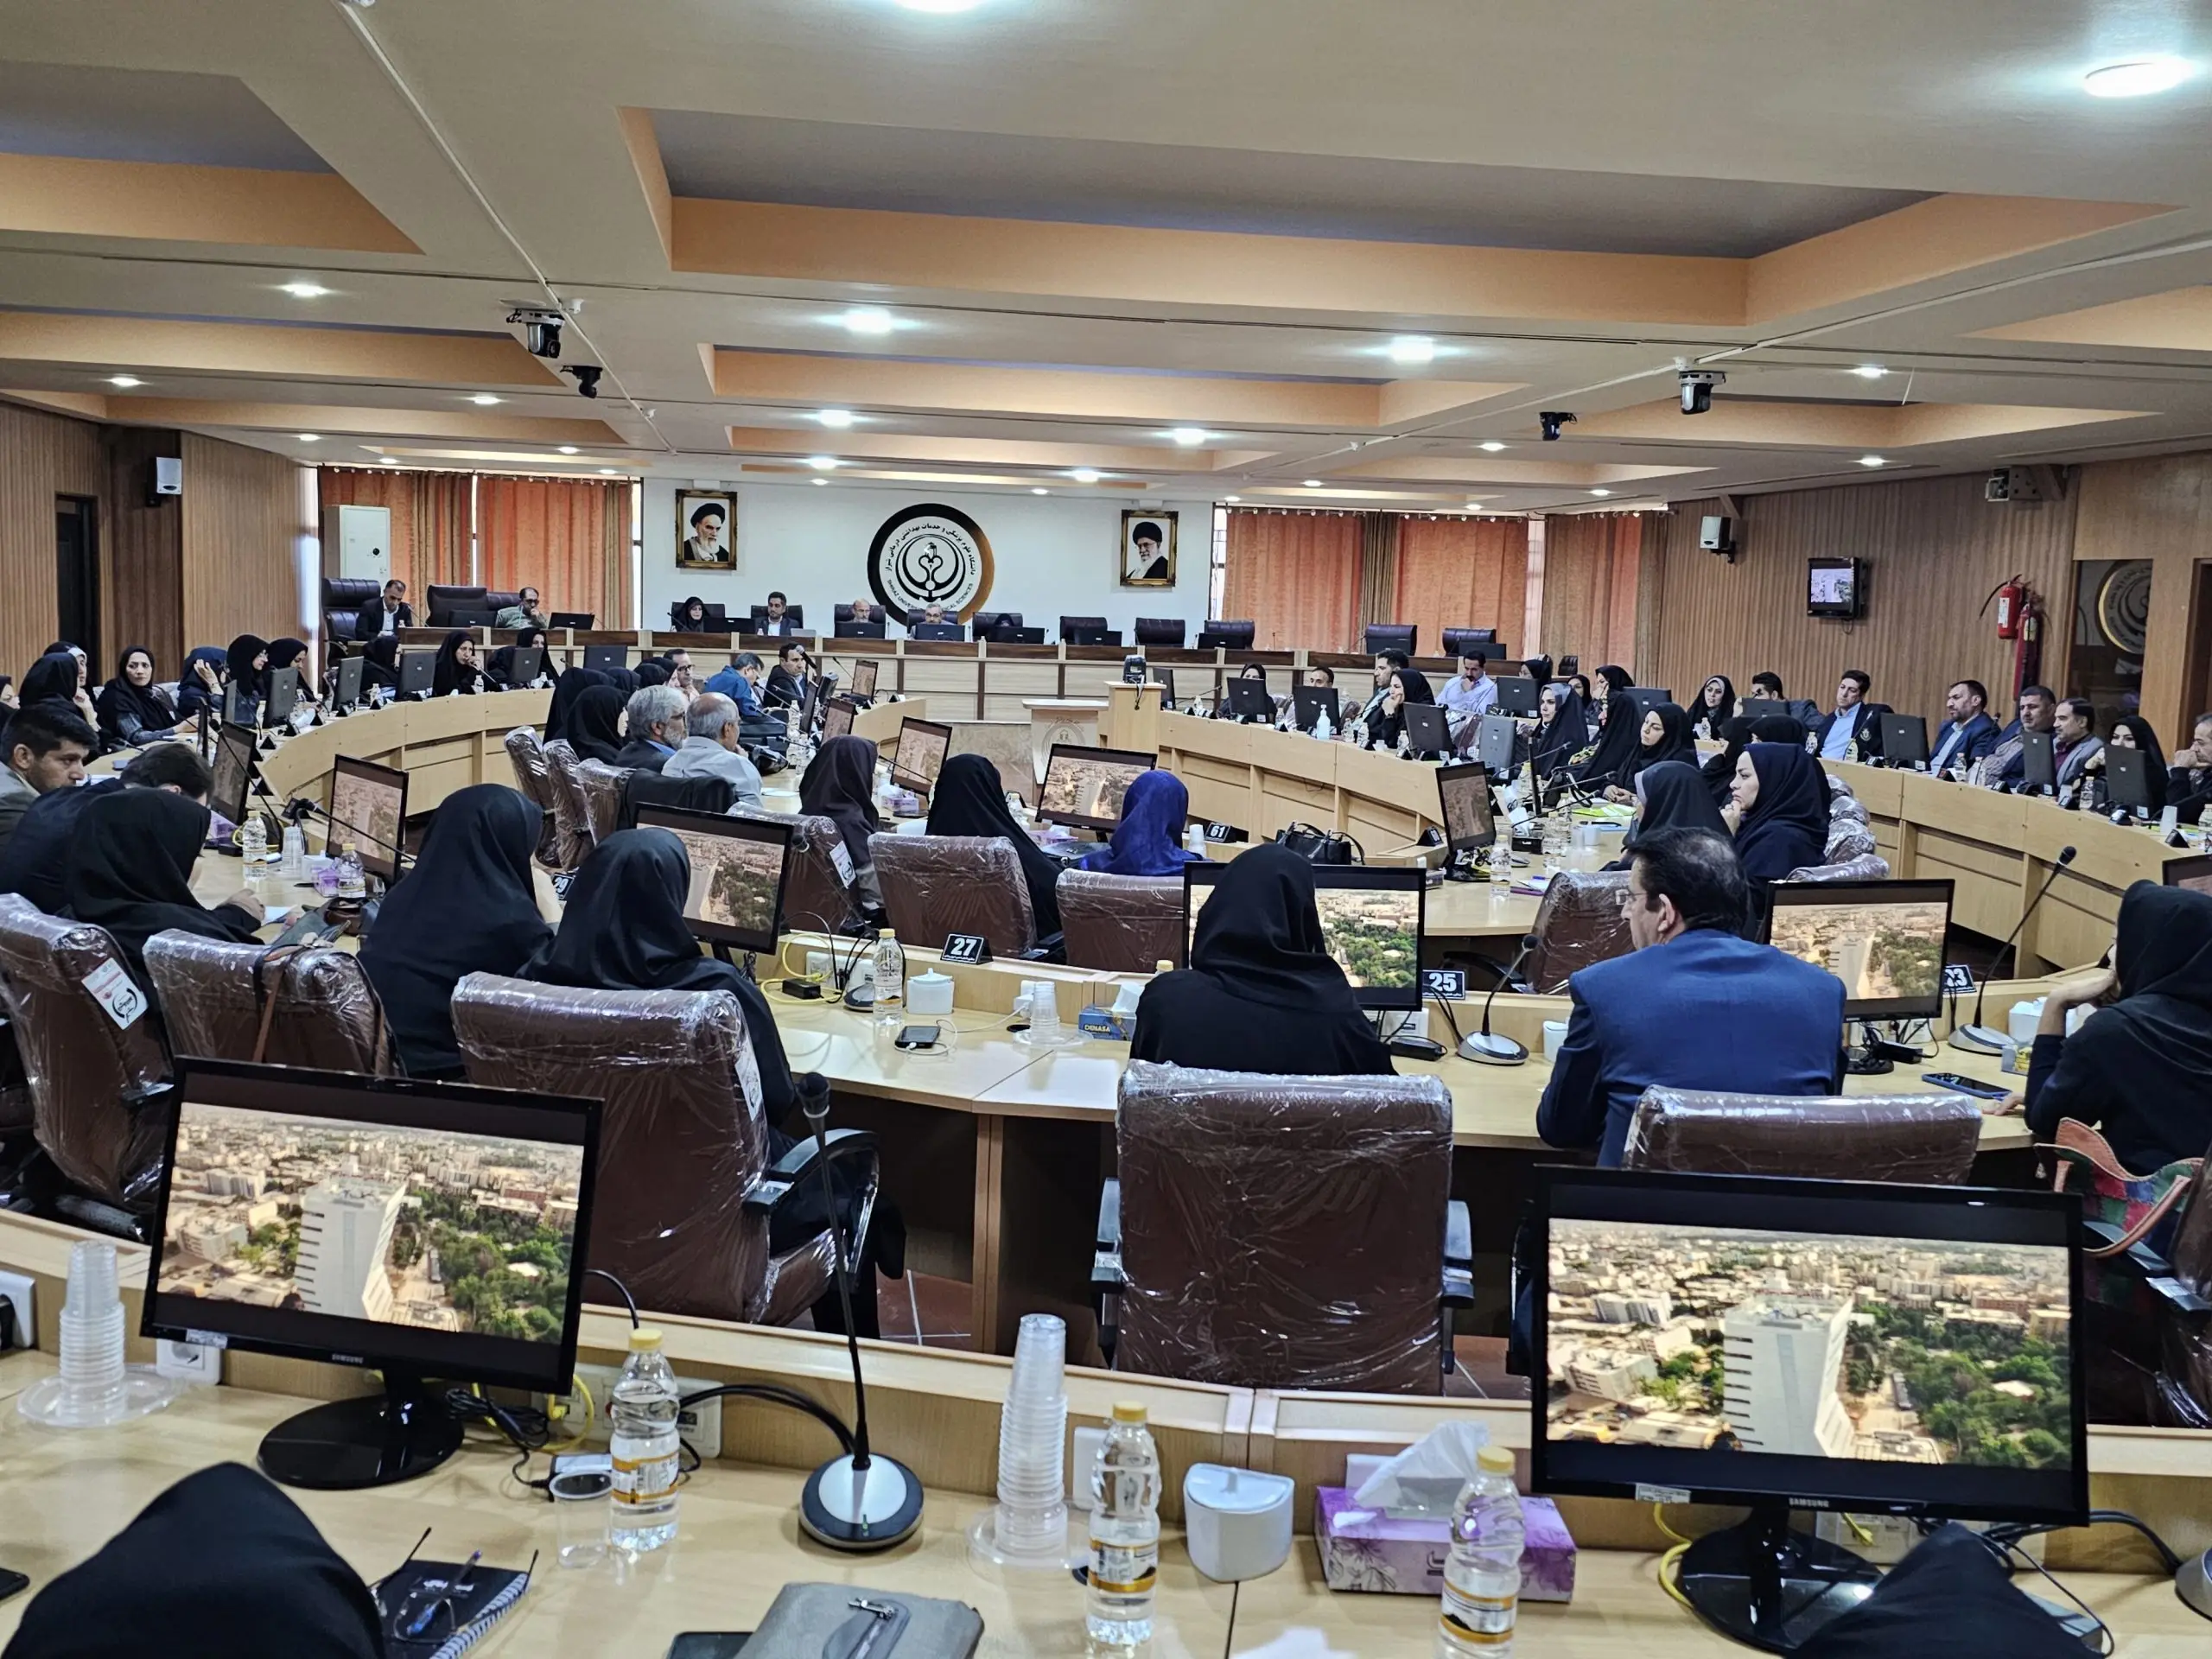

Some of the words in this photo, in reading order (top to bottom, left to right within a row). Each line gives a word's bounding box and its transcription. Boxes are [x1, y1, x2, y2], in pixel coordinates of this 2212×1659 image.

[955, 582, 974, 604] SCIENCES
[1210, 825, 1226, 838] 61
[950, 938, 977, 956] 27
[1428, 972, 1457, 992] 25
[1789, 1497, 1829, 1508] SAMSUNG
